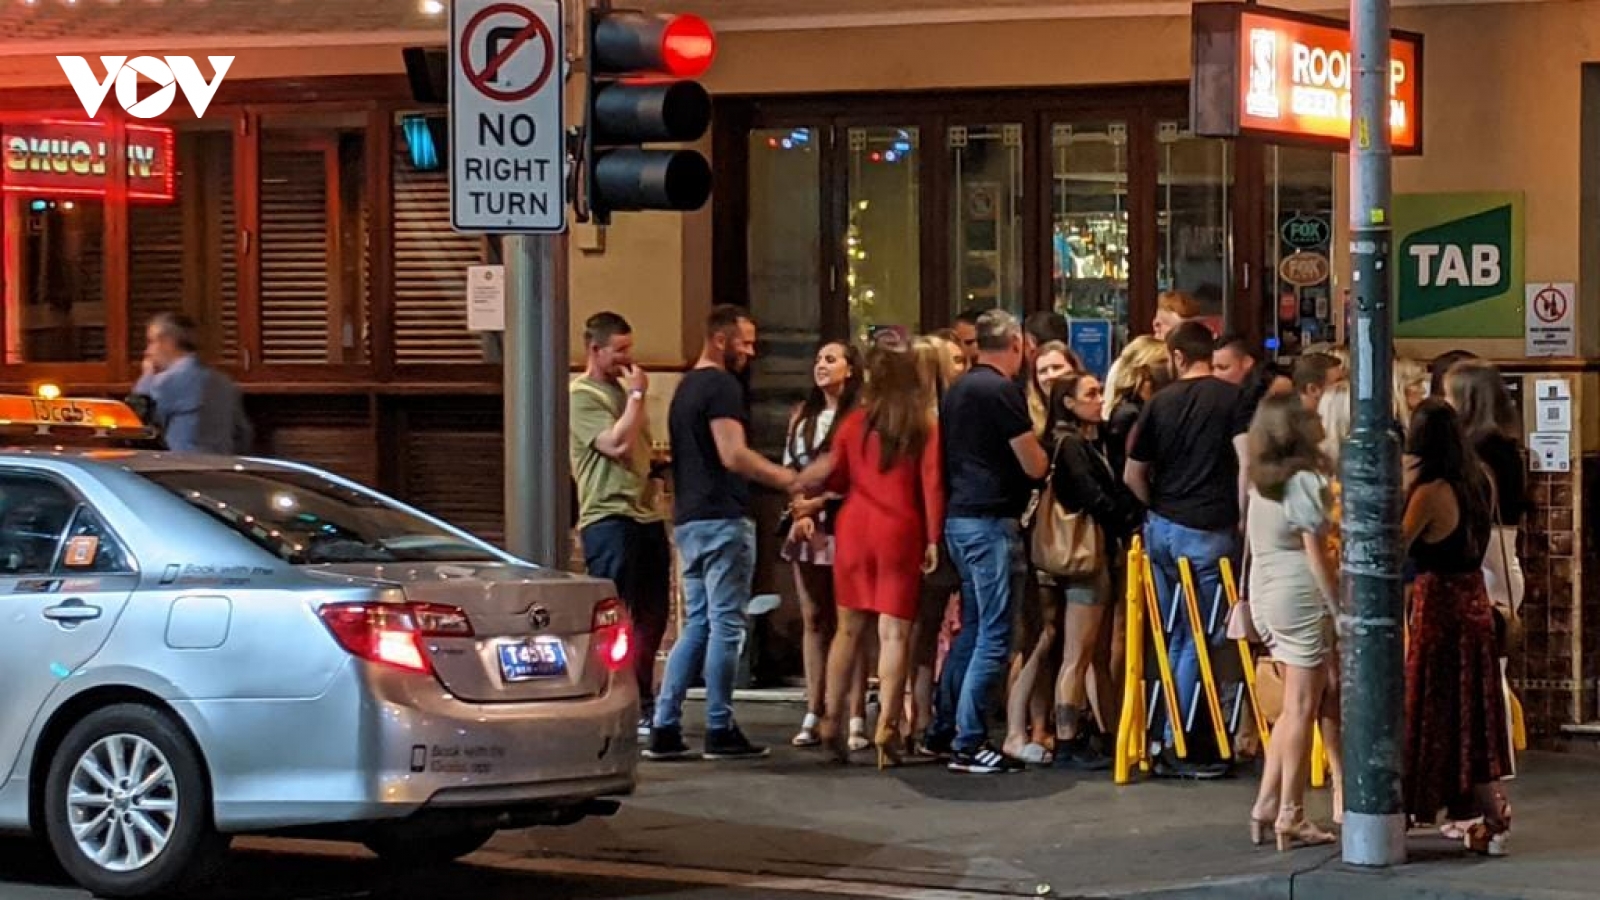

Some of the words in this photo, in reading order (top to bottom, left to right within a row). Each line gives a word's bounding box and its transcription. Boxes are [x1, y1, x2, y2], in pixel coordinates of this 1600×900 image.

[1292, 42, 1405, 97] ROOP
[478, 113, 536, 147] NO
[465, 158, 550, 181] RIGHT
[469, 191, 548, 215] TURN
[1290, 222, 1320, 239] FOX
[1409, 244, 1500, 286] TAB
